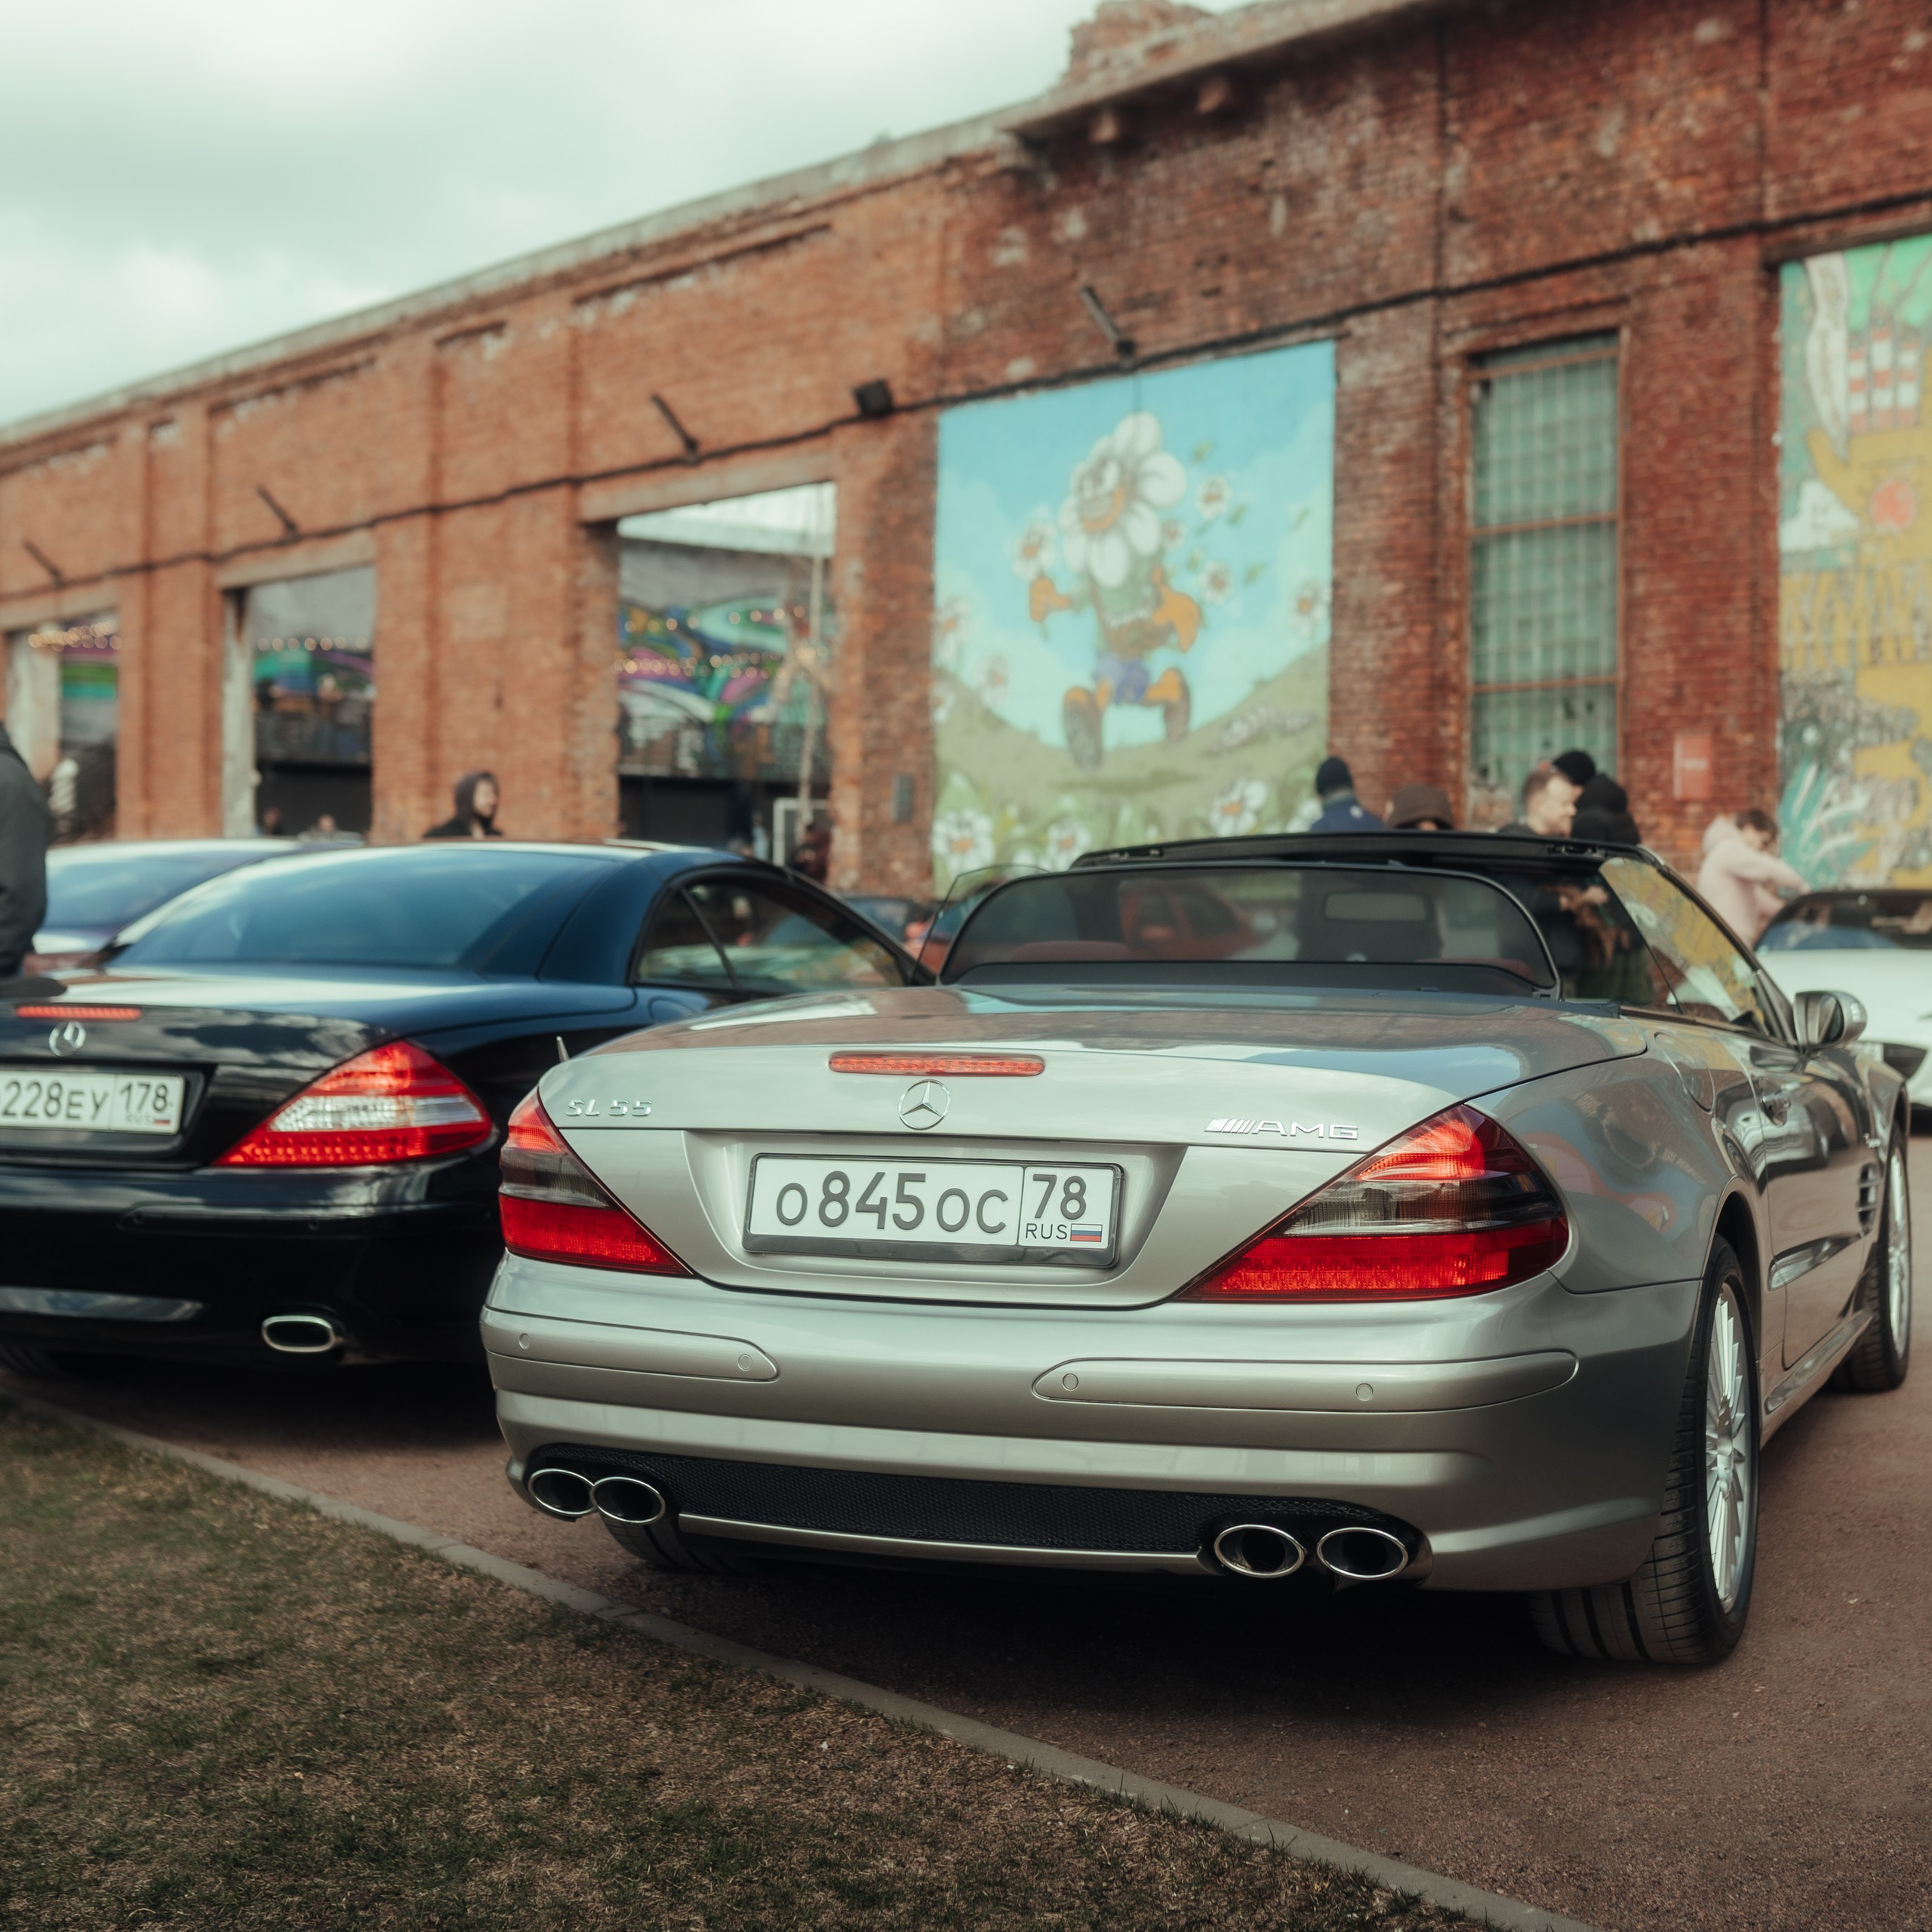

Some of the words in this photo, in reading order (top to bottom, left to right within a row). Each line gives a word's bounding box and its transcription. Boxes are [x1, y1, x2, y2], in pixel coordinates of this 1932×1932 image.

[118, 1082, 169, 1113] 178
[565, 1098, 600, 1117] SL
[608, 1099, 653, 1117] 55
[1251, 1120, 1358, 1140] AMG
[1032, 1173, 1088, 1220] 78
[1025, 1223, 1068, 1241] RUS
